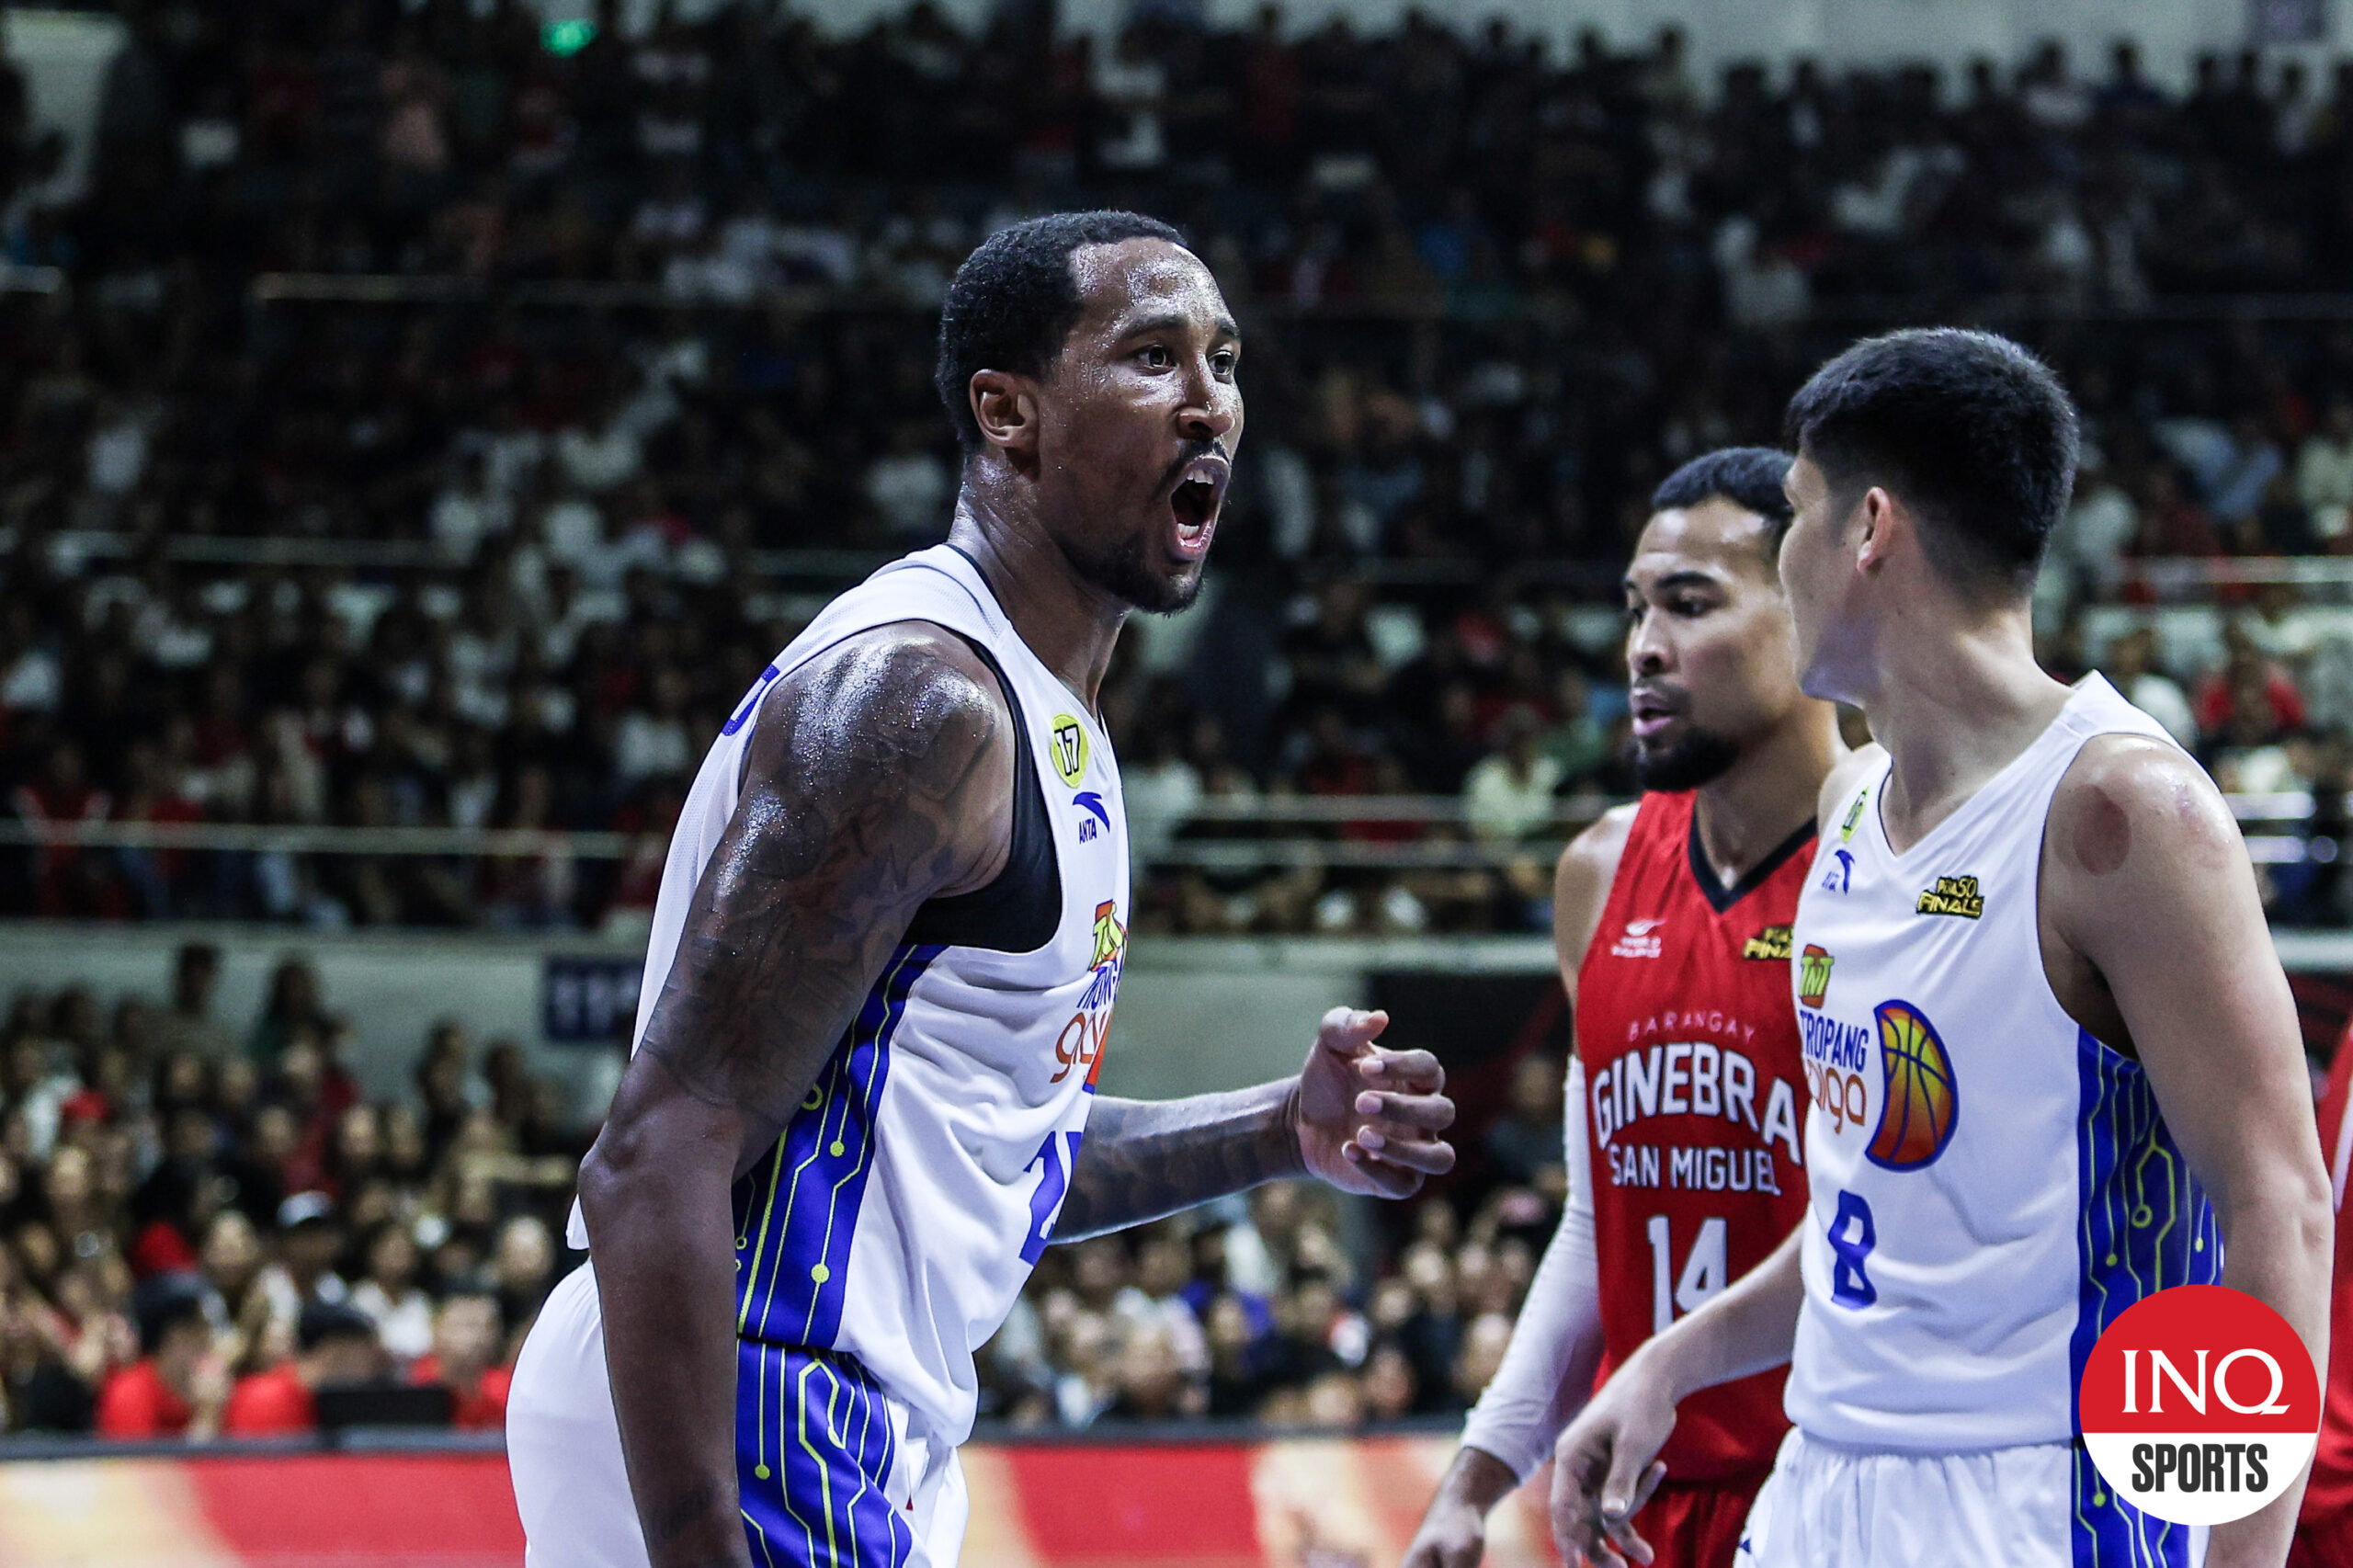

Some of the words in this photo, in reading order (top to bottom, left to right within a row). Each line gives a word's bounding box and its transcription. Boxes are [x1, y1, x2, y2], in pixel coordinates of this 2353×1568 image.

[1054, 723, 1080, 777] 17
[1079, 818, 1097, 844] ANTA
[1917, 891, 1981, 917] FINALS
[1744, 937, 1792, 959] FINA
[1799, 955, 1835, 998] TNT
[1628, 1011, 1755, 1044] BARANGAY
[1800, 1010, 1870, 1074] TROPANG
[1592, 1041, 1802, 1166] GINEBRA
[1609, 1143, 1660, 1188] SAN
[1670, 1145, 1782, 1196] MIGUEL
[1647, 1214, 1728, 1335] 14
[1827, 1189, 1878, 1311] 8
